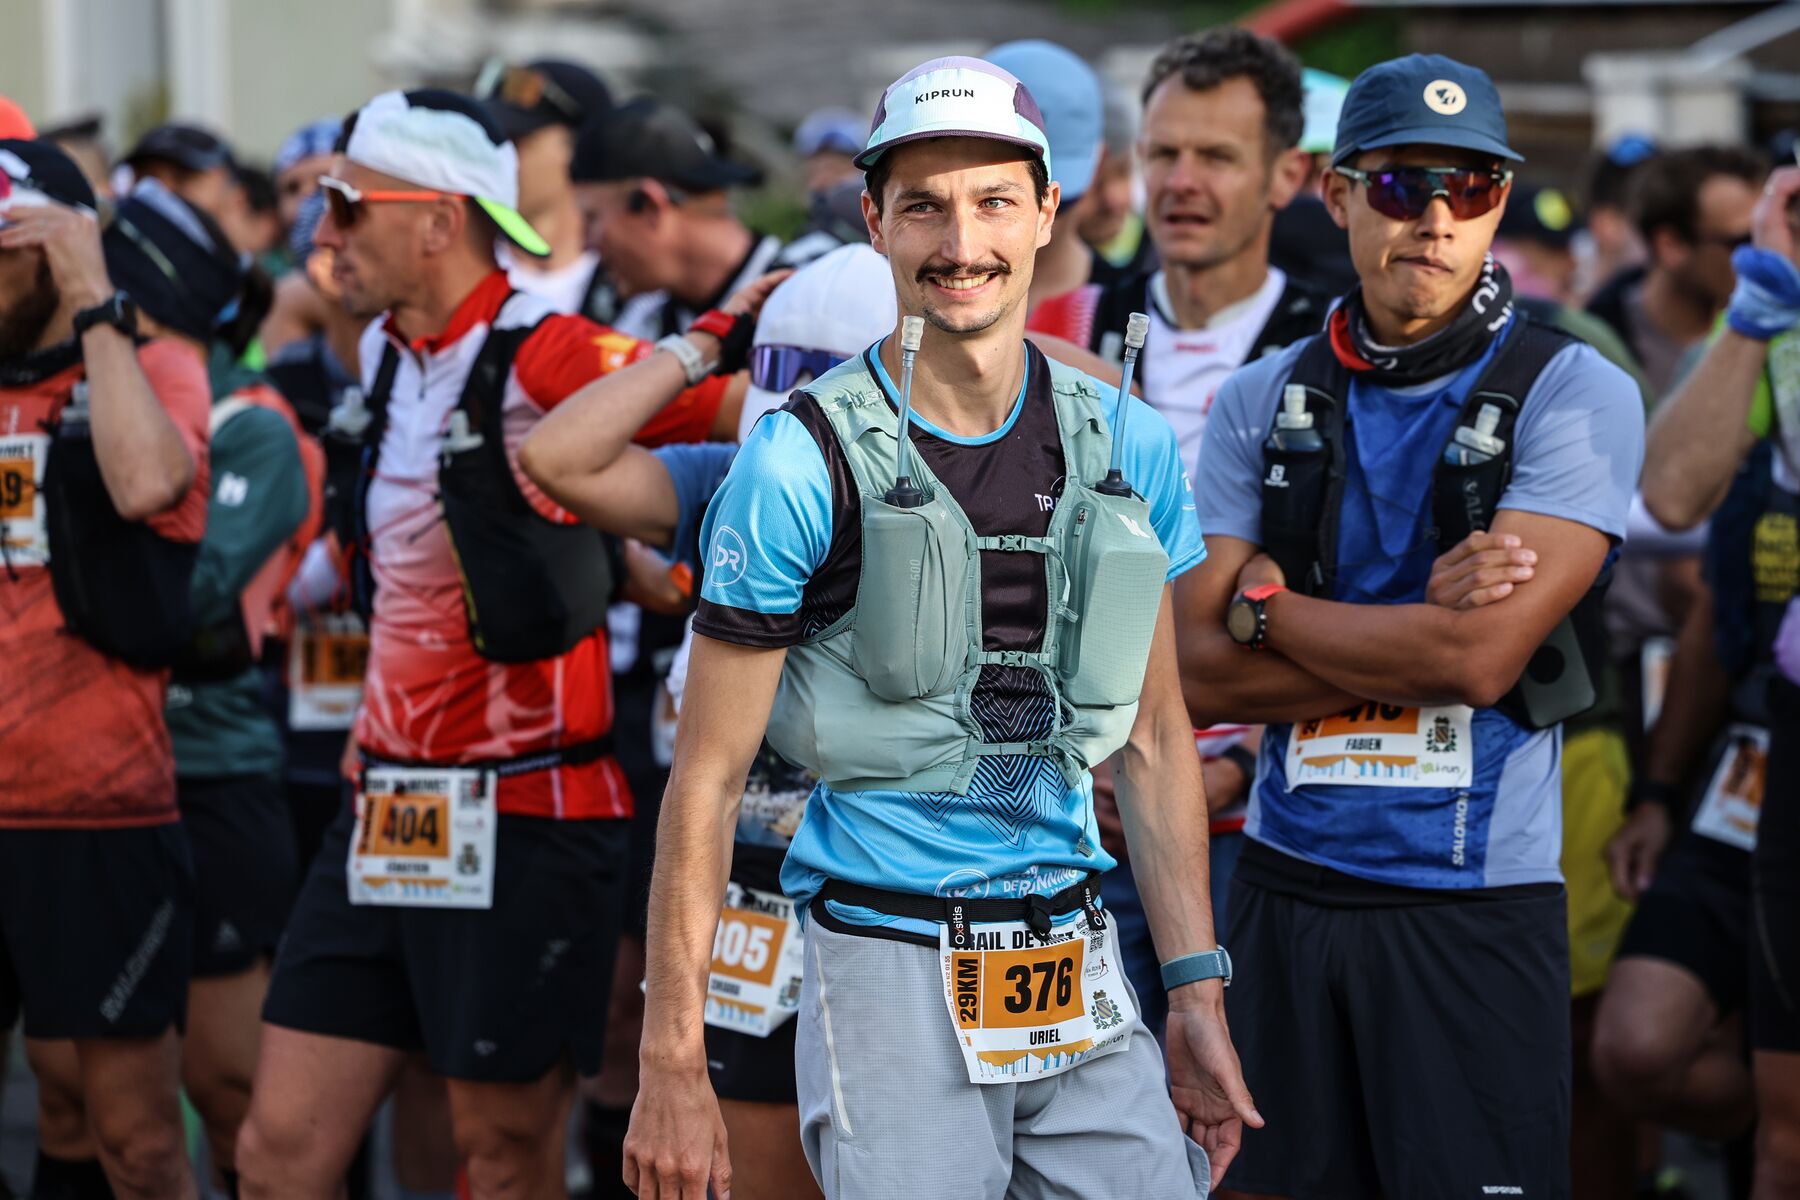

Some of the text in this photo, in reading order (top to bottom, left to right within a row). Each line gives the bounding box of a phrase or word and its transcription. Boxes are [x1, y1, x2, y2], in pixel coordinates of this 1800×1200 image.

[915, 88, 974, 105] KIPRUN
[714, 544, 740, 571] DR
[909, 559, 921, 581] 500
[1344, 737, 1382, 752] FABIEN
[382, 805, 438, 847] 404
[1452, 791, 1470, 866] SALOMON
[1084, 887, 1103, 926] Oxsitis
[952, 905, 965, 945] Oxsitis
[1012, 930, 1034, 949] DE
[957, 958, 979, 1023] 29KM
[1004, 957, 1074, 1014] 376
[1029, 1028, 1061, 1046] URIEL
